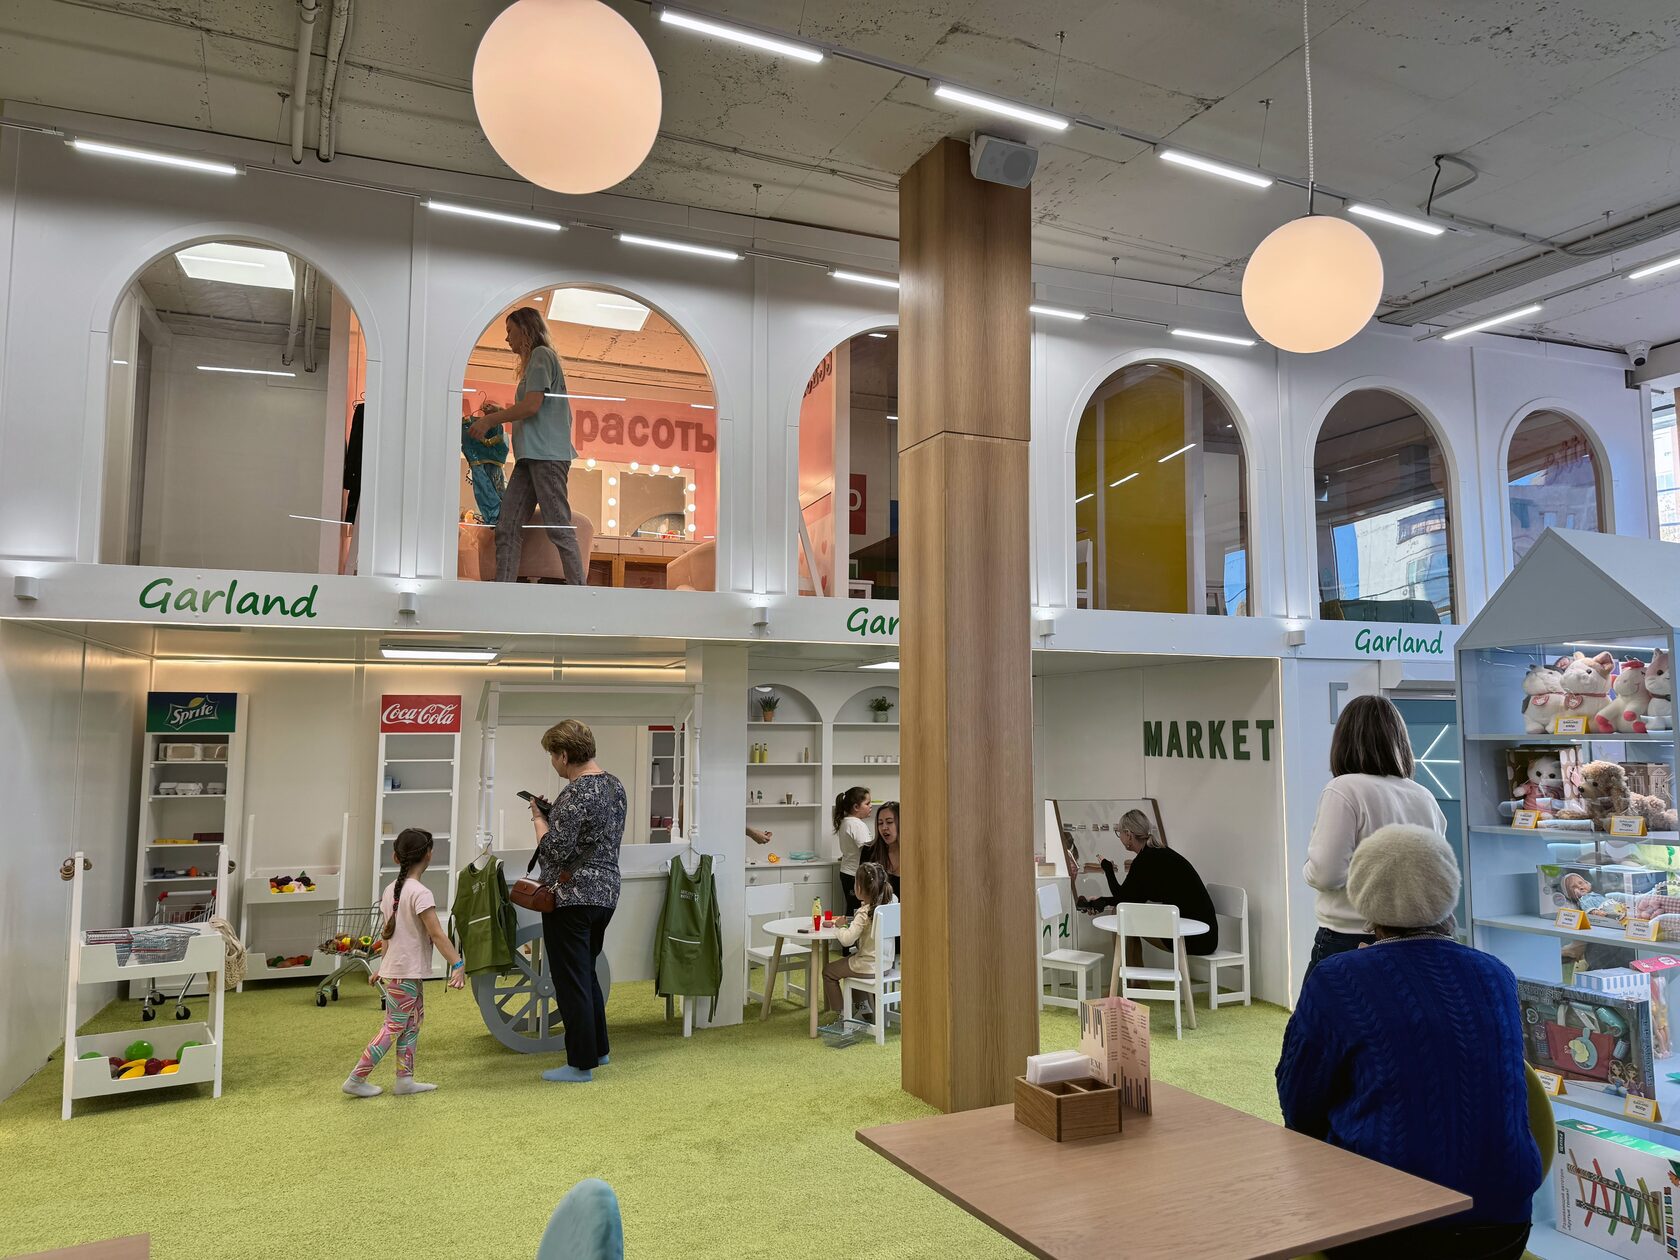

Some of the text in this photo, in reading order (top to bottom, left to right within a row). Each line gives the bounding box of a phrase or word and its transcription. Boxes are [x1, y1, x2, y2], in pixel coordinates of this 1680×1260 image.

[138, 578, 318, 618] Garland
[1354, 628, 1444, 655] Garland
[170, 702, 213, 725] Sprite
[382, 703, 458, 725] Coca-Cola
[1143, 720, 1275, 761] MARKET
